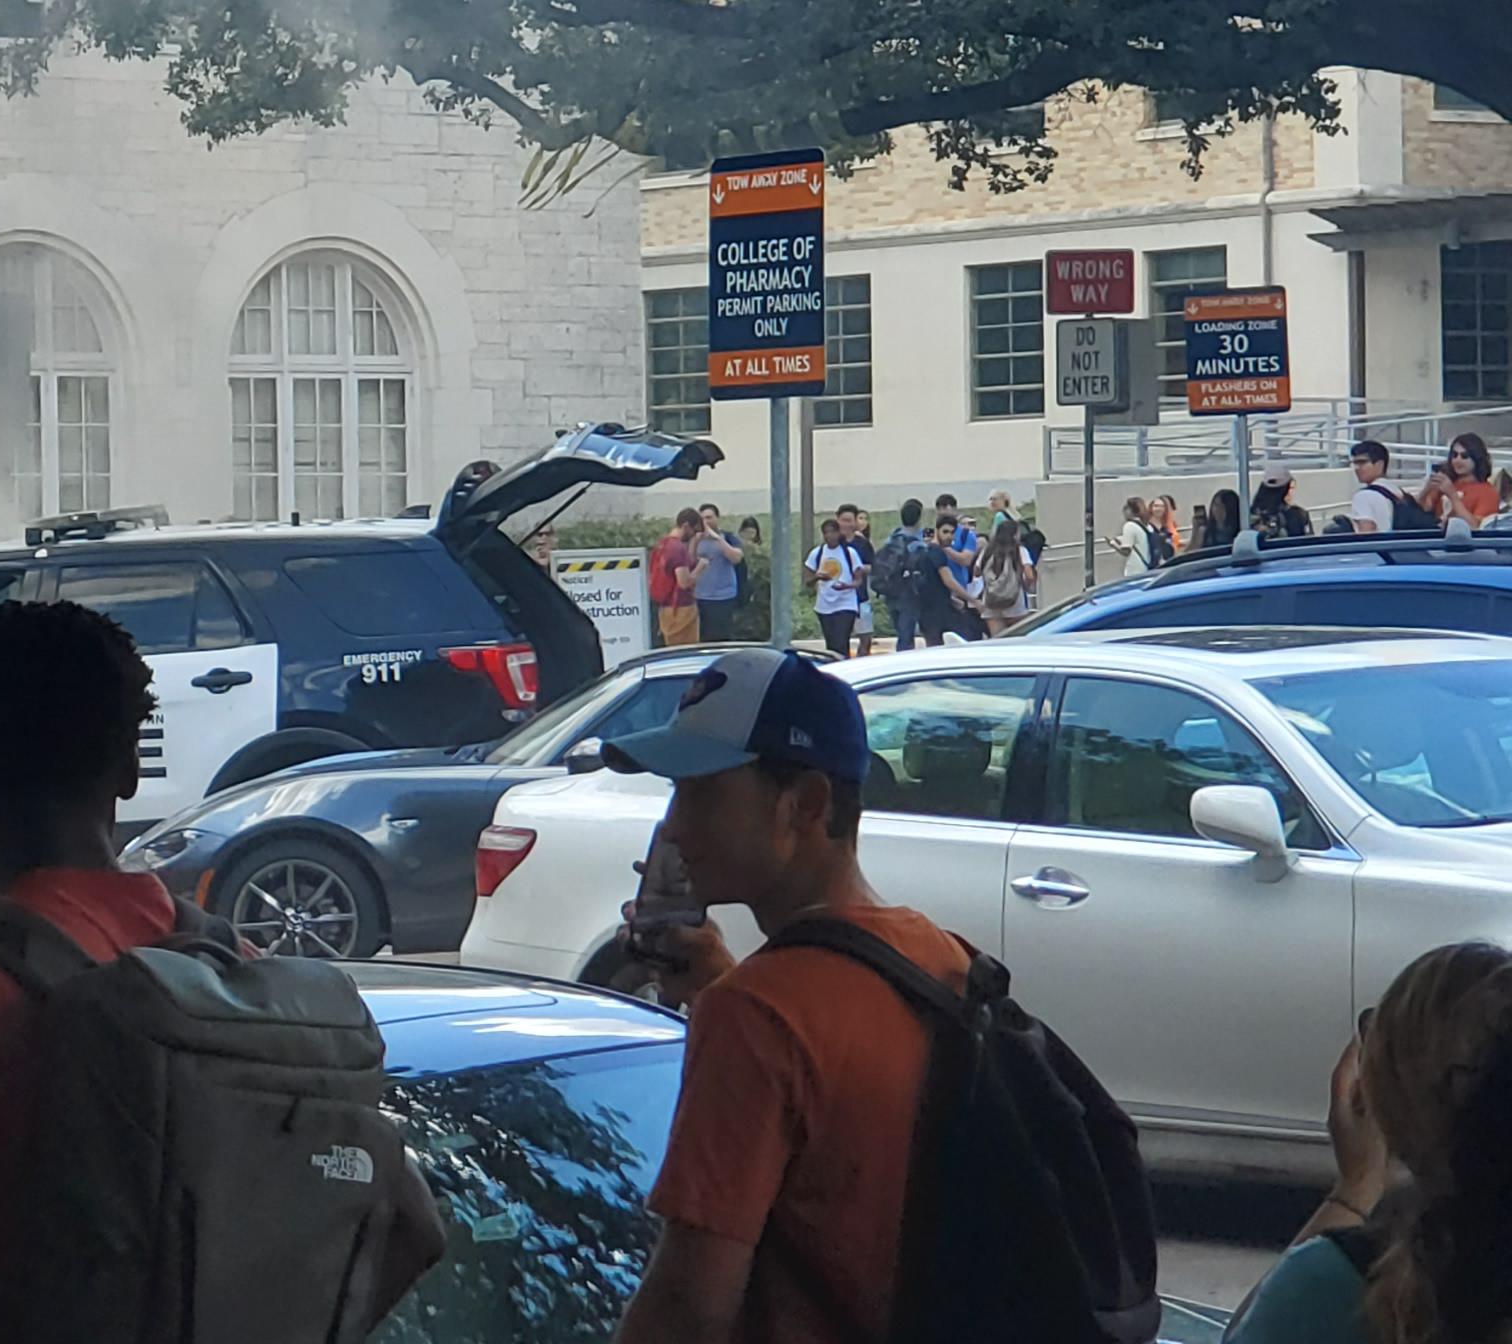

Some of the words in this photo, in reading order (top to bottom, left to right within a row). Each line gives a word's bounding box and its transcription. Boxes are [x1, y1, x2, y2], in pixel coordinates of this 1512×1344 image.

[727, 176, 748, 191] TOW
[751, 172, 778, 188] AWAY
[780, 169, 807, 185] ZONE
[718, 238, 788, 265] COLLEGE
[793, 236, 815, 259] OF
[726, 265, 812, 293] PHARMACY
[1056, 260, 1124, 279] WRONG
[718, 296, 763, 316] PERMIT
[767, 292, 821, 314] PARKING
[1070, 284, 1109, 304] WAY
[754, 317, 788, 337] ONLY
[1076, 326, 1096, 346] DO
[1194, 321, 1245, 333] LOADING
[1247, 320, 1278, 331] ZONE
[1219, 334, 1249, 354] 30
[724, 358, 742, 377] AT
[745, 357, 769, 375] ALL
[772, 354, 810, 374] TIMES
[1071, 351, 1100, 371] NOT
[1195, 356, 1280, 376] MINUTES
[1063, 375, 1110, 397] ENTER
[1201, 380, 1257, 393] FLASHERS
[1260, 379, 1277, 390] ON
[1201, 396, 1217, 407] AT
[1245, 394, 1278, 405] TIMES
[566, 588, 601, 602] losed
[606, 588, 623, 601] for
[343, 650, 422, 666] EMERGENCY
[361, 662, 401, 684] 911
